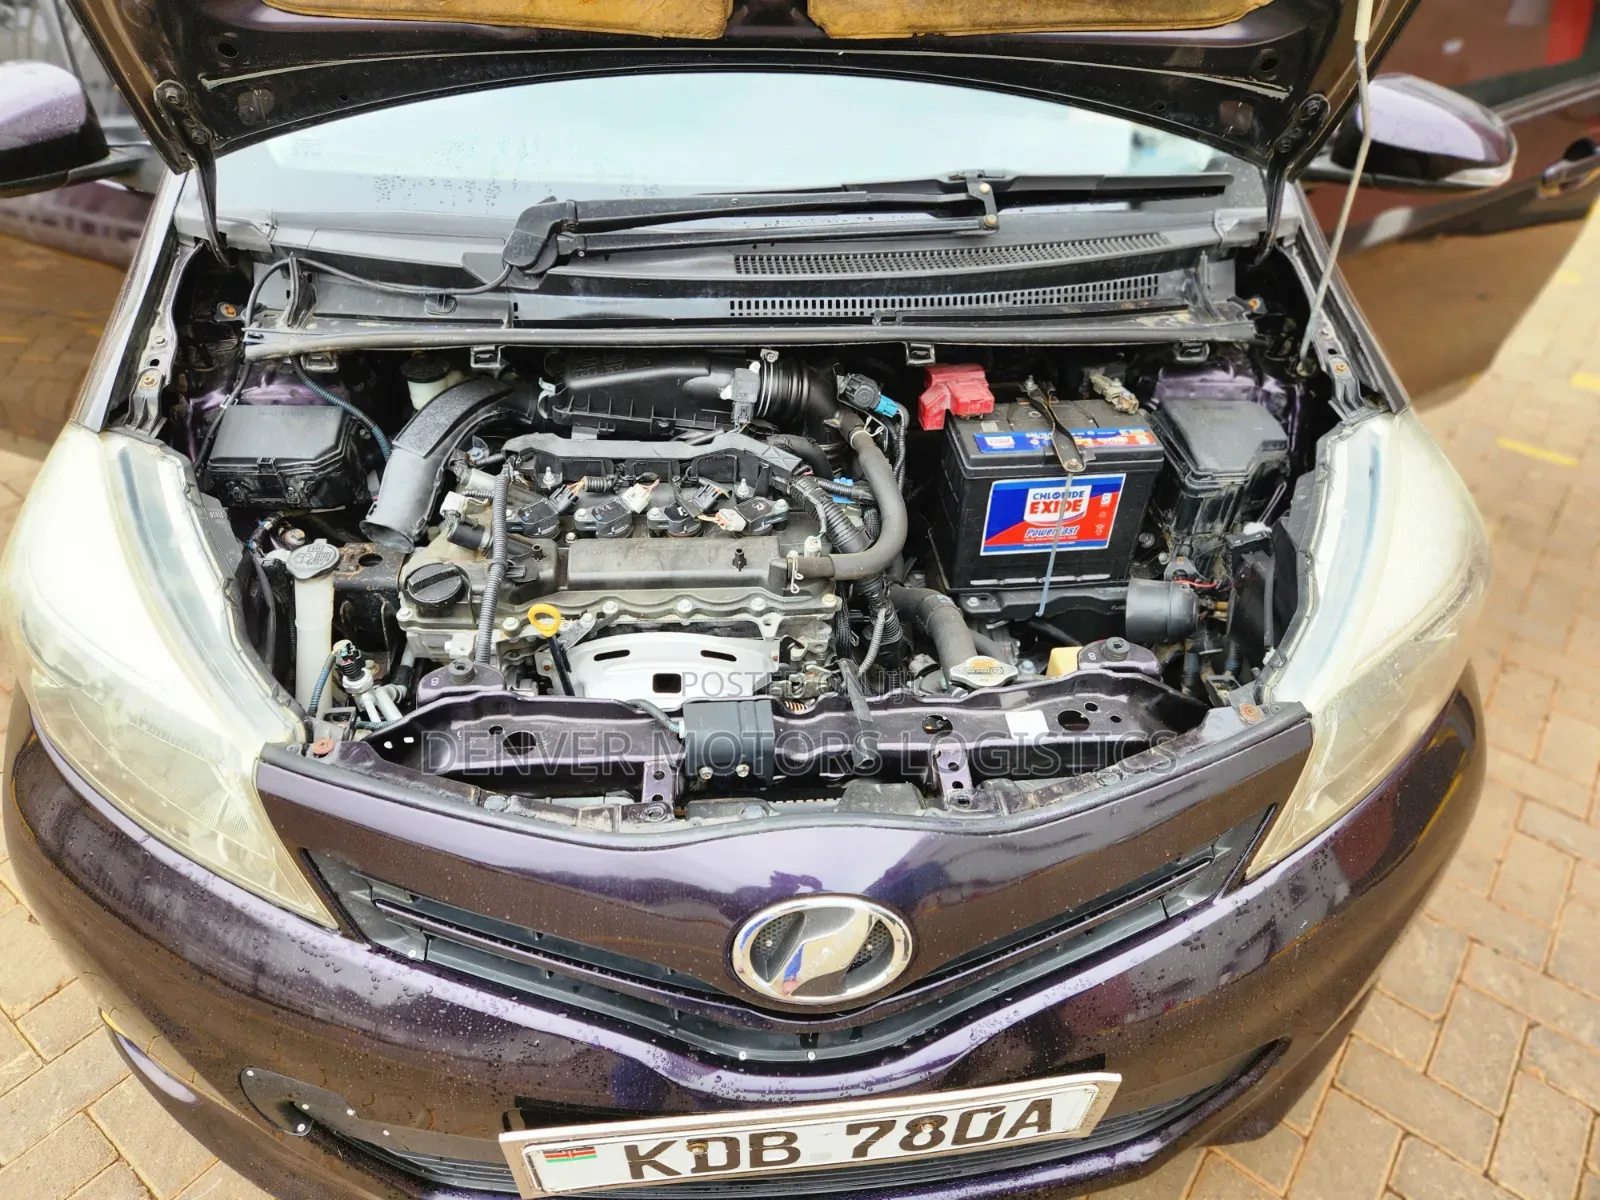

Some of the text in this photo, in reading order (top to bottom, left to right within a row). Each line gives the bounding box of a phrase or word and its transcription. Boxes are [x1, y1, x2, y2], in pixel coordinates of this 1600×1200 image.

[1029, 498, 1084, 515] EXIDE
[624, 1097, 1053, 1180] KDB 780A
